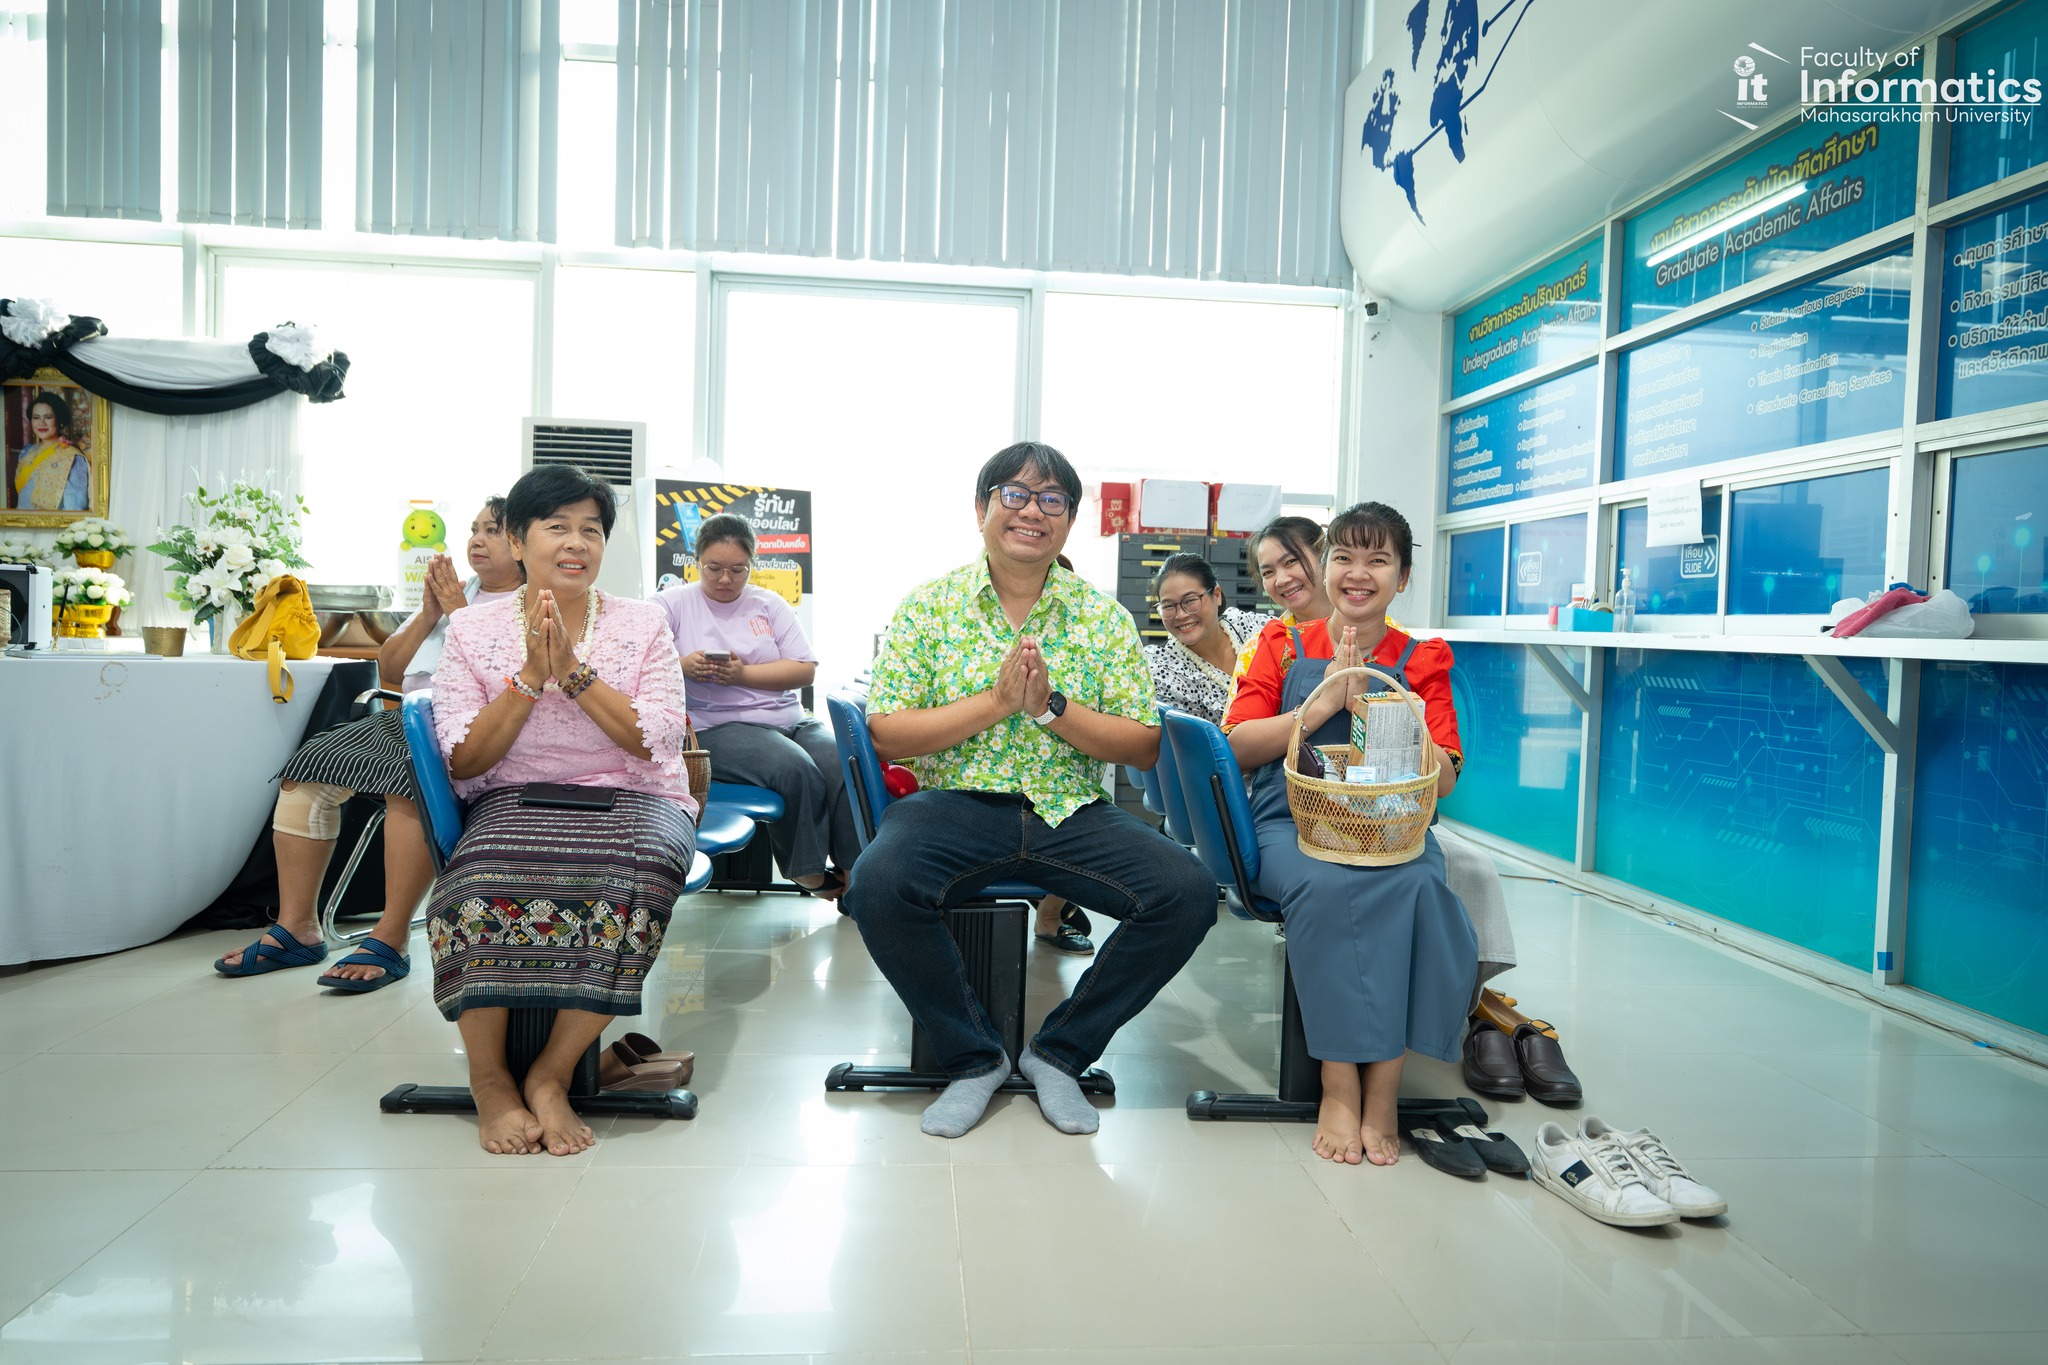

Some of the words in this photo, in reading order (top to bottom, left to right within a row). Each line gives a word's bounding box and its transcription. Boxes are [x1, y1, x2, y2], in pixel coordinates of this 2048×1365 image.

[1655, 241, 1719, 286] Graduate
[1723, 202, 1801, 256] Academic
[1806, 179, 1864, 223] Affairs
[1469, 260, 1588, 343] งานวิชาการระดับปริญญาตรี
[1760, 307, 1788, 330] Submit
[1790, 298, 1822, 319] various
[1824, 282, 1865, 308] requests
[1462, 337, 1518, 375] Undergraduate
[1520, 315, 1564, 348] Academic
[1567, 299, 1597, 326] Affairs
[1758, 332, 1808, 358] Registration
[1757, 368, 1782, 387] Thesis
[1783, 353, 1838, 379] Examination
[1756, 393, 1799, 415] Graduate
[1799, 380, 1847, 405] Consulting
[1849, 369, 1892, 392] Services
[748, 515, 800, 532] ออนไลน์
[754, 493, 796, 518] รู้ทัน!
[1685, 562, 1702, 574] SLIDE
